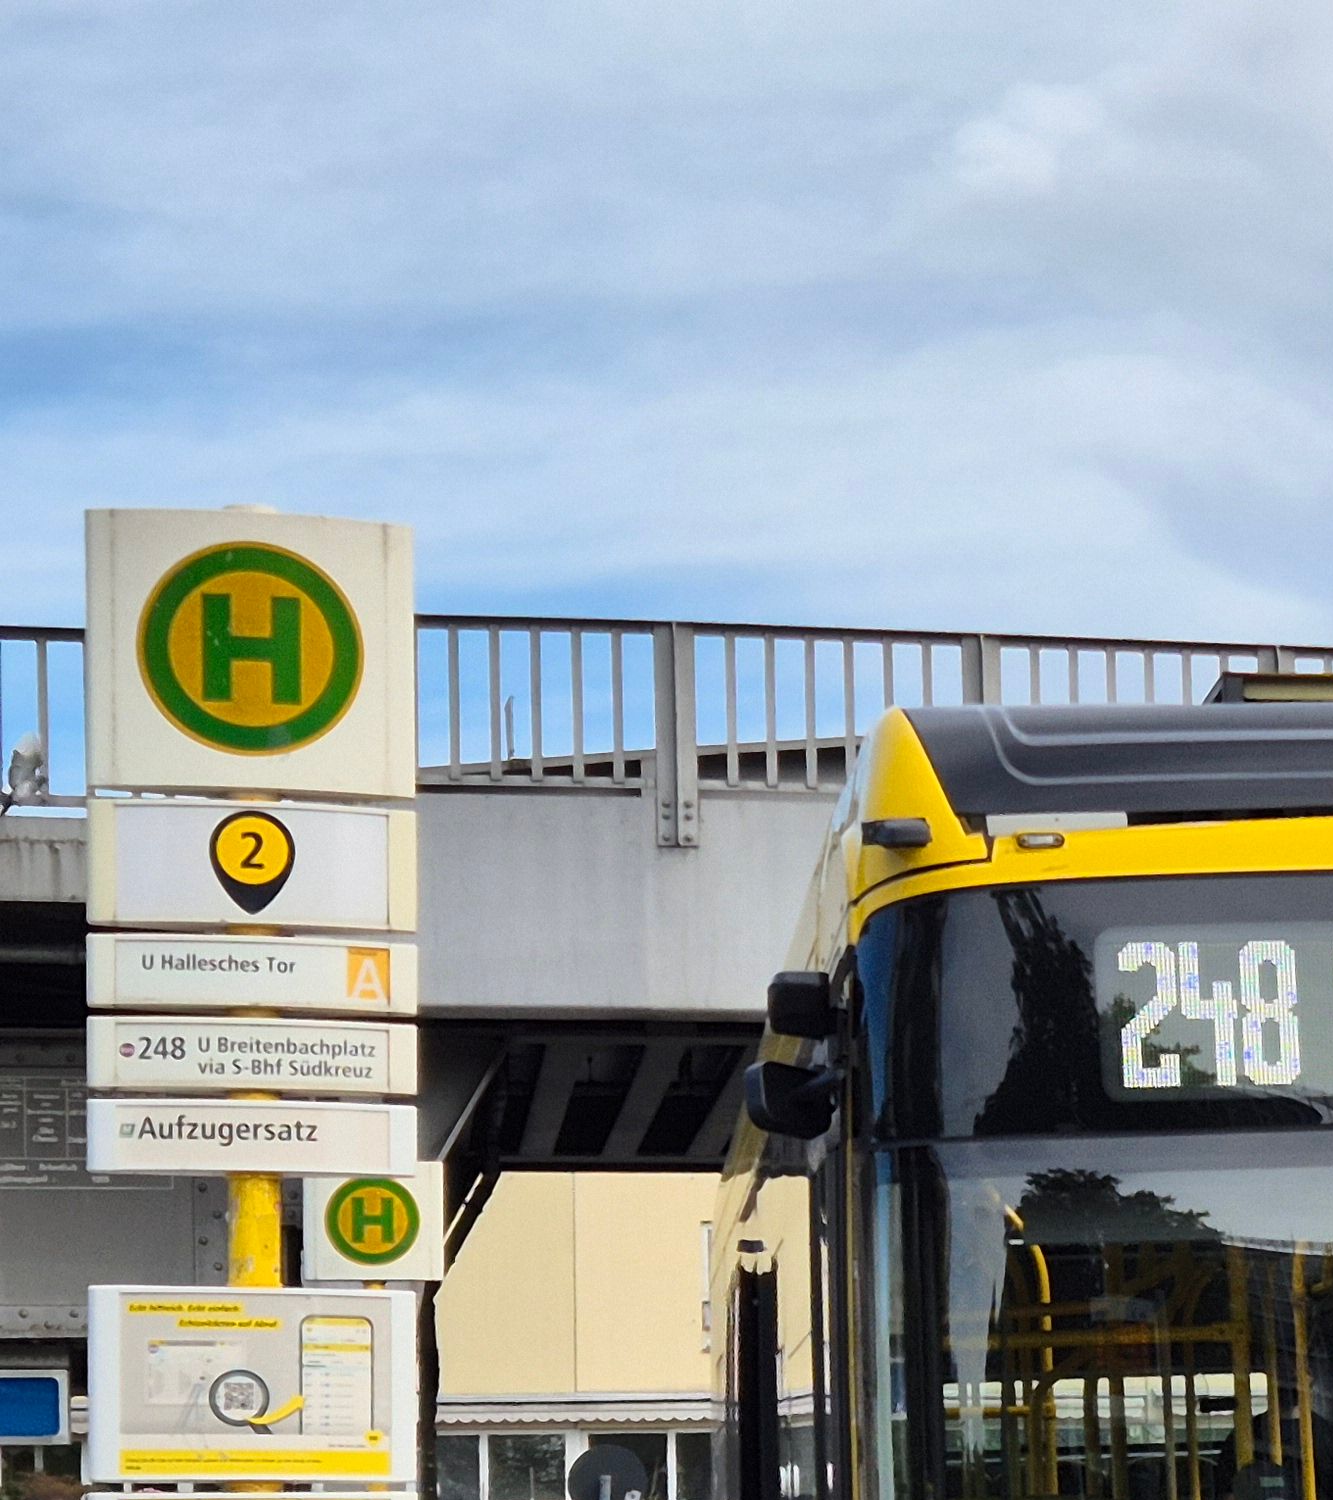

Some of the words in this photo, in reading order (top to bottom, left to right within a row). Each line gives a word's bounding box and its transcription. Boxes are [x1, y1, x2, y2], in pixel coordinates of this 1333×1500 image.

[203, 593, 301, 706] H
[240, 831, 265, 870] 2
[141, 955, 155, 971] U
[160, 953, 260, 973] Hallesches
[266, 956, 296, 974] Tor
[351, 958, 388, 1002] A
[1117, 939, 1300, 1090] 248
[138, 1036, 187, 1060] 248
[198, 1037, 211, 1053] U
[217, 1036, 376, 1059] Breitenbachplatz
[198, 1059, 225, 1076] via
[232, 1058, 283, 1076] S-Bhf
[289, 1058, 373, 1080] Südkreuz
[137, 1115, 319, 1147] Aufzugersatz
[351, 1196, 396, 1244] H
